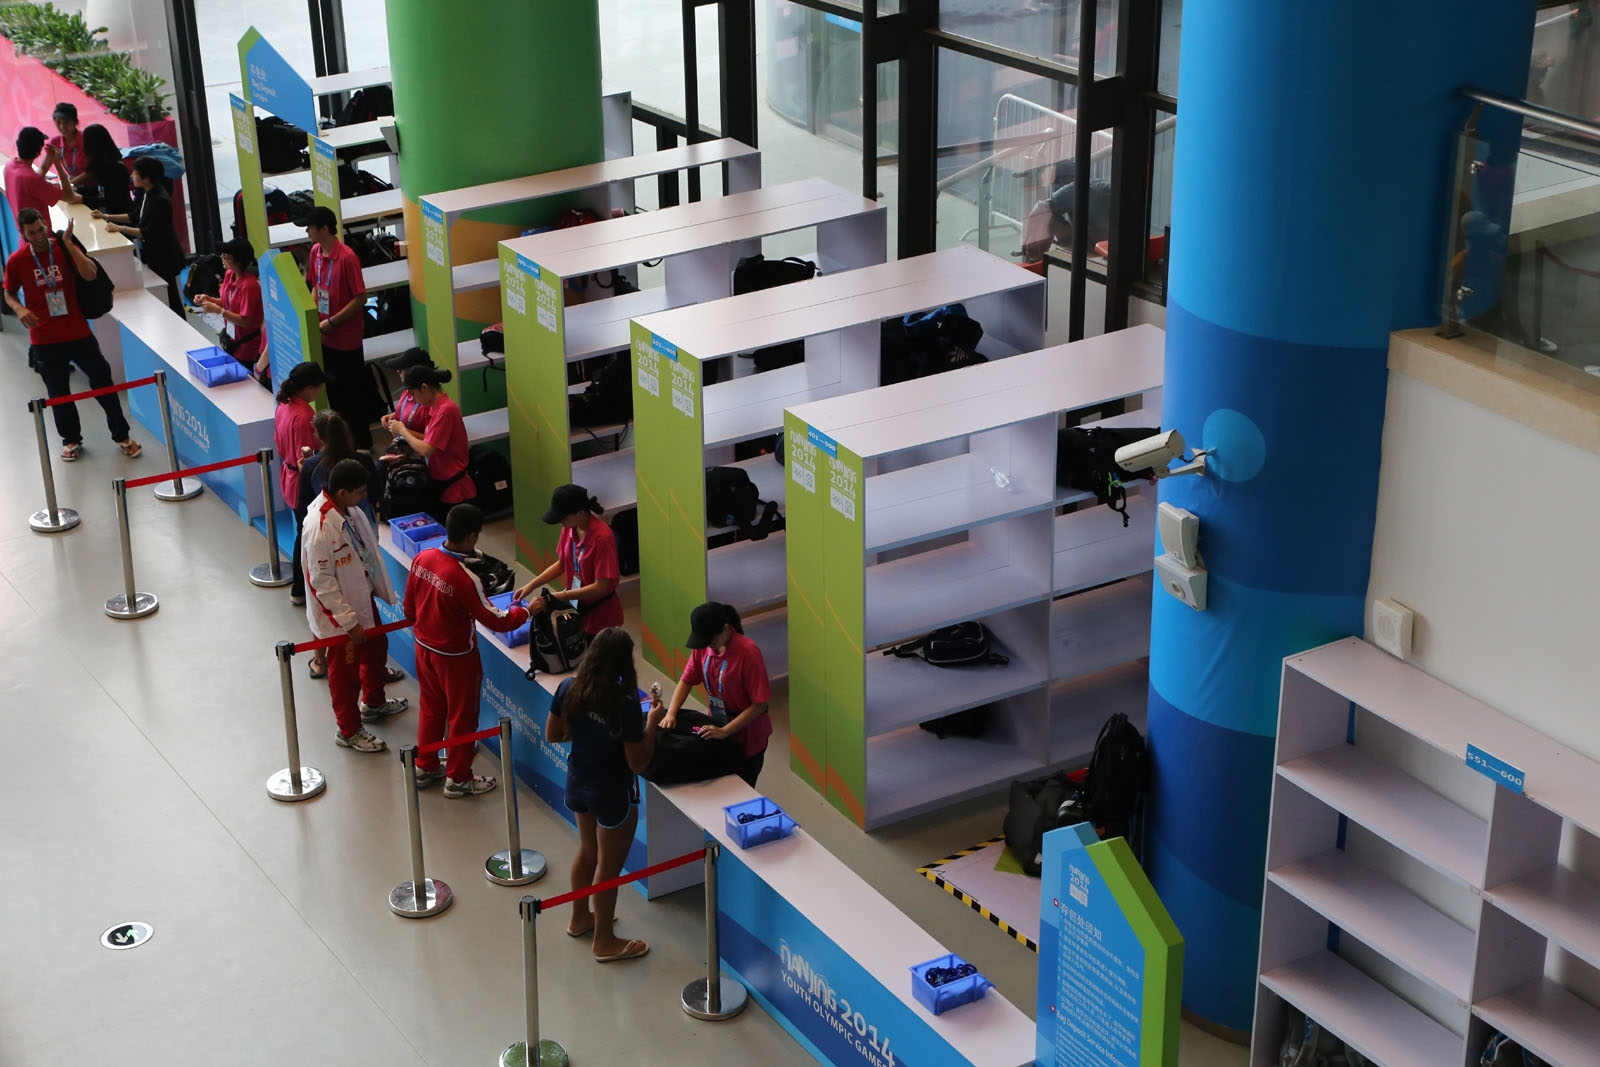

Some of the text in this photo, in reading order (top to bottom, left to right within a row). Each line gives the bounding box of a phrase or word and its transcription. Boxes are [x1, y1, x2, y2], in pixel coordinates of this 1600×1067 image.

[425, 227, 444, 248] 2014
[505, 273, 526, 298] 2014
[536, 290, 558, 315] 2014
[637, 352, 660, 378] 2014
[671, 372, 695, 399] 2014
[184, 408, 210, 449] 2014
[791, 443, 817, 473] 2014
[830, 470, 857, 500] 2014
[1070, 872, 1090, 895] 2014
[1060, 902, 1103, 942] 存包处须知
[781, 969, 812, 1006] YOUTH
[812, 1000, 854, 1046] OLYMPIC
[840, 997, 897, 1067] 2014
